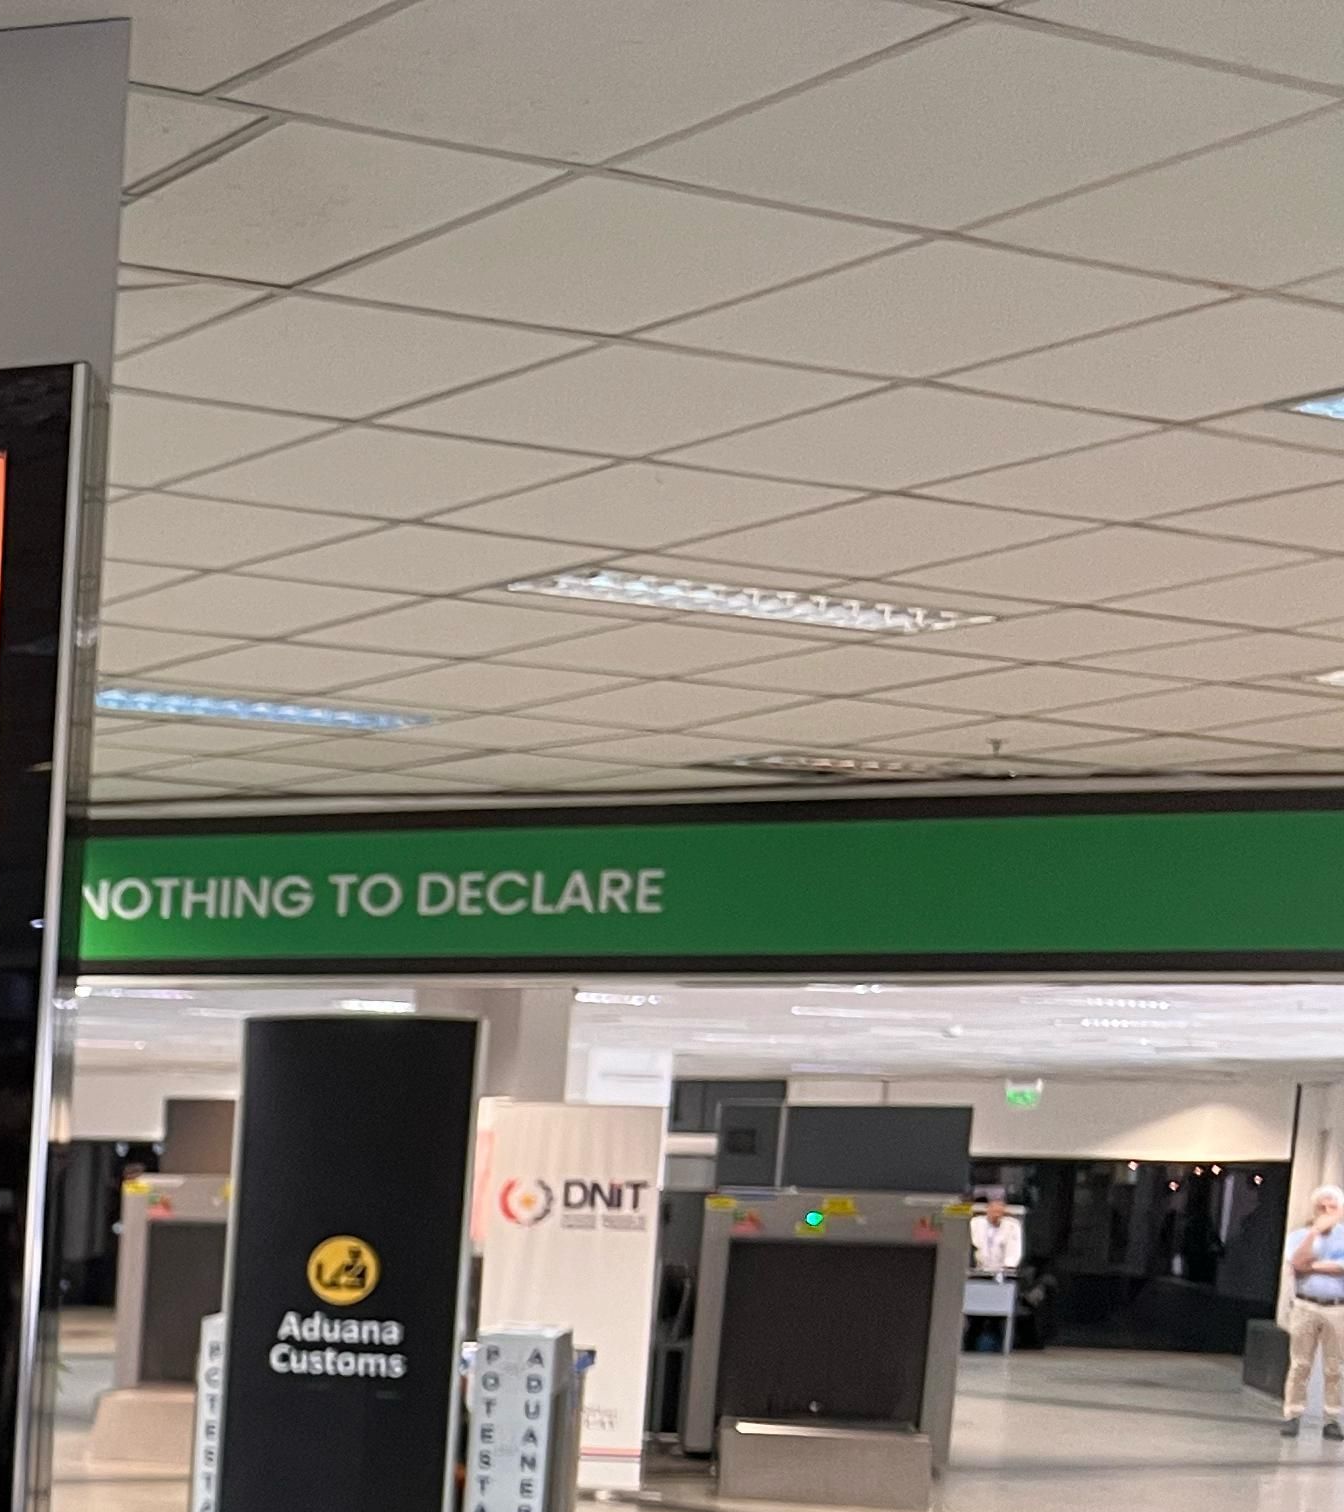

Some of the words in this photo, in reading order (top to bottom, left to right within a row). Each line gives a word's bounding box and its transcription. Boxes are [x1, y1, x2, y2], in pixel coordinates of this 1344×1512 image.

[82, 874, 314, 921] NOTHING
[328, 873, 403, 918] TO
[417, 868, 666, 917] DECLARE
[277, 1311, 404, 1345] Aduana
[269, 1343, 407, 1378] Customs
